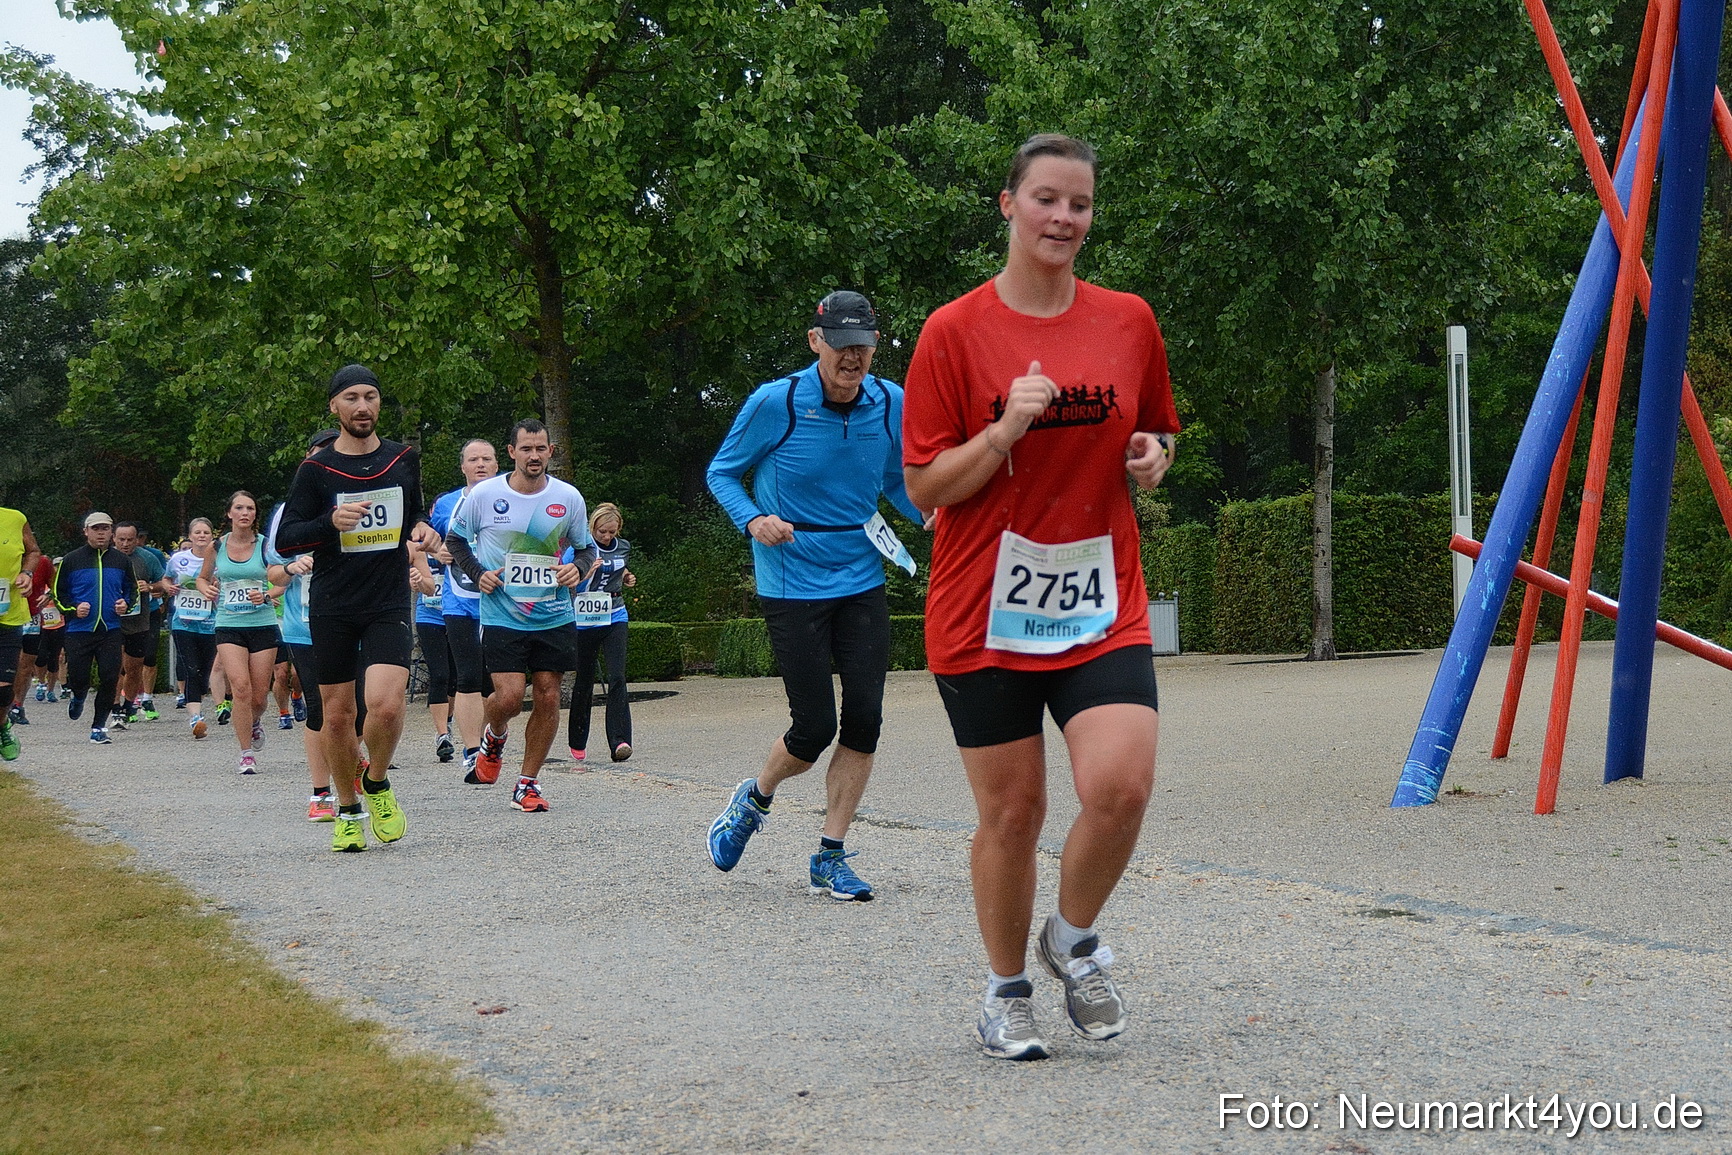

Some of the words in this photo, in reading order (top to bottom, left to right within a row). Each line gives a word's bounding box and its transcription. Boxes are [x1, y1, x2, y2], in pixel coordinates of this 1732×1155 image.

[361, 504, 388, 528] 59
[357, 533, 394, 544] Stephan
[511, 565, 553, 585] 2015
[1006, 564, 1105, 611] 2754
[180, 596, 208, 610] 2591
[578, 600, 609, 613] 2094
[1024, 619, 1082, 637] Nadine
